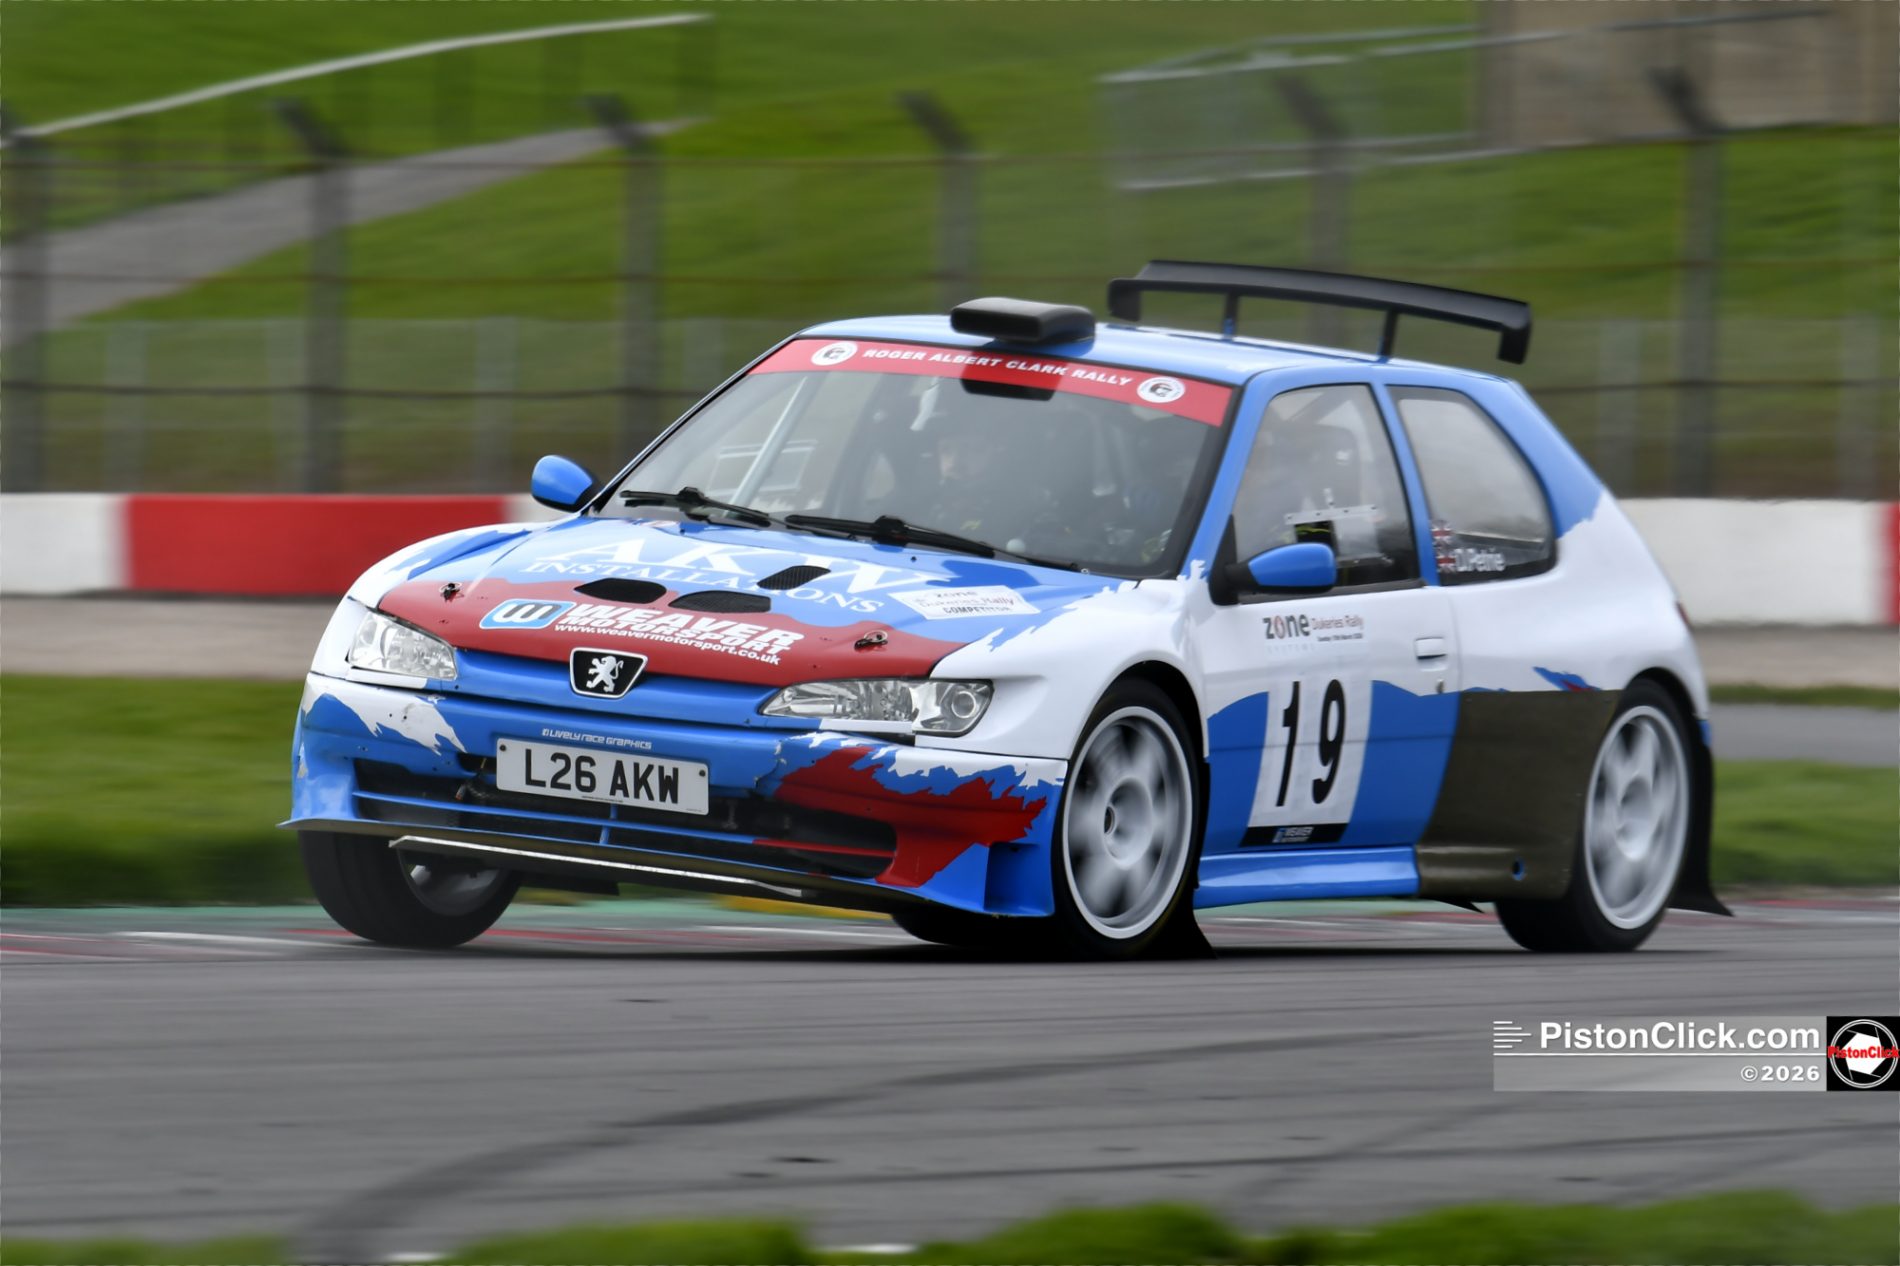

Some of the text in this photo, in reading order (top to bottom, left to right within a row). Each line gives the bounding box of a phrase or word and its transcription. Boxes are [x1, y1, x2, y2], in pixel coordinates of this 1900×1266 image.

[862, 348, 1134, 386] ROGER ALBERT CLARK RALLY
[520, 562, 884, 613] INSTALLAONS
[983, 596, 1015, 606] Rally
[554, 624, 782, 666] www.weavermotorsport.co.uk
[558, 616, 792, 654] MOTORSPORT
[566, 603, 805, 646] WEAVER
[1262, 614, 1310, 640] zone
[1275, 679, 1347, 807] 19
[525, 748, 679, 804] L26 AKW
